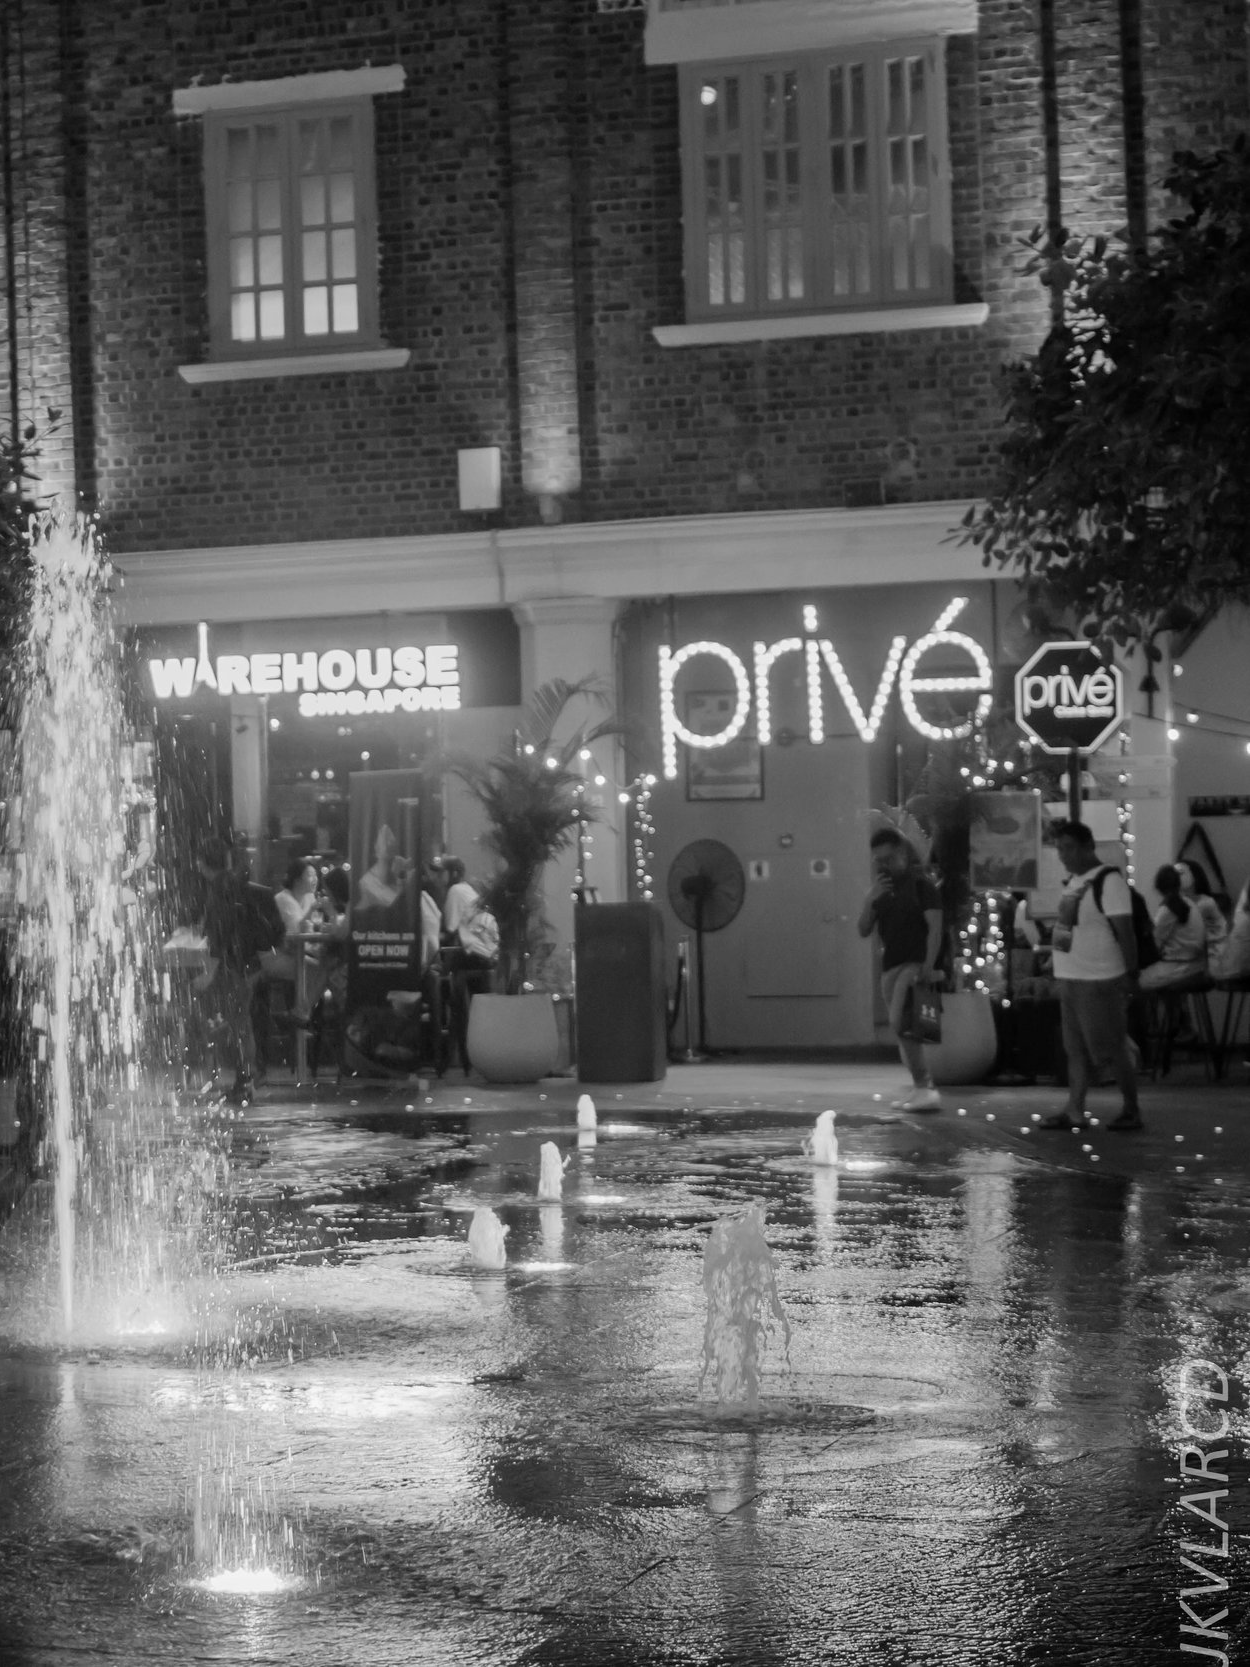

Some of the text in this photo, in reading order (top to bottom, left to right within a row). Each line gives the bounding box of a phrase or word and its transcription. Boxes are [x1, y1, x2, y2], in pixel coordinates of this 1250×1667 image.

[149, 621, 459, 698] WAREHOUSE
[299, 685, 460, 716] SINGAPORE
[659, 597, 993, 780] privé
[1022, 664, 1115, 716] privé
[358, 944, 410, 956] OPEN NOW
